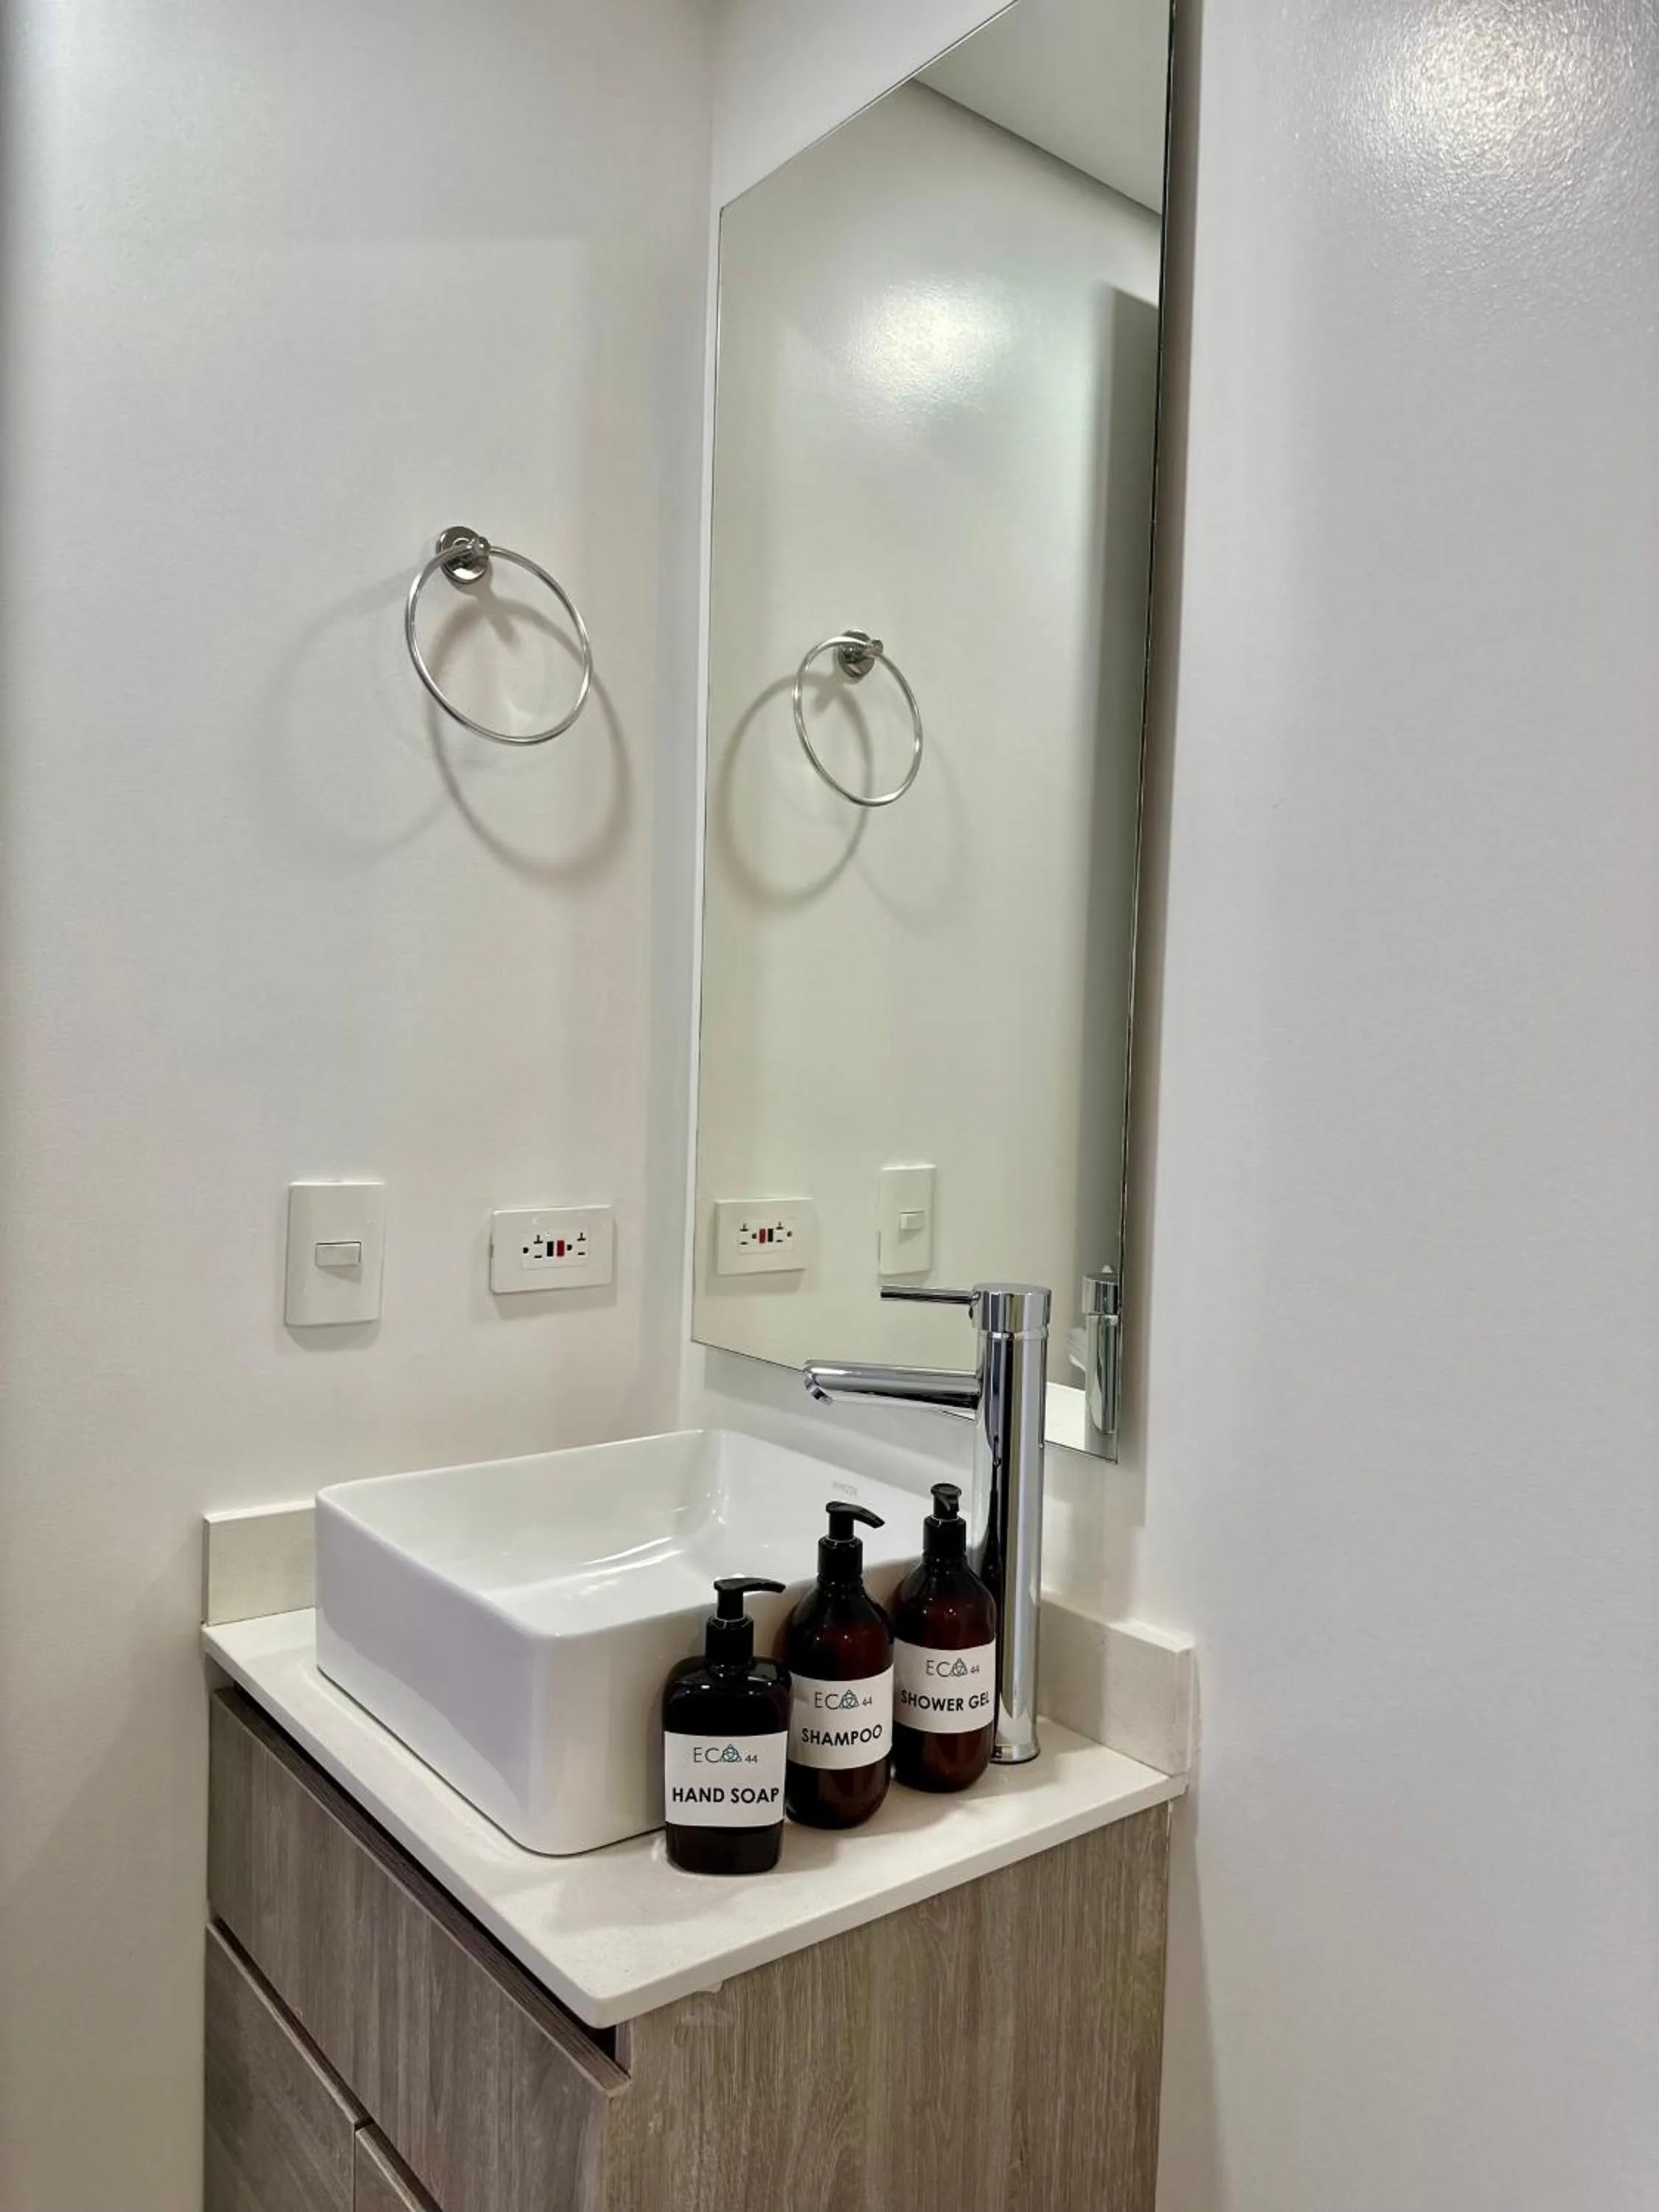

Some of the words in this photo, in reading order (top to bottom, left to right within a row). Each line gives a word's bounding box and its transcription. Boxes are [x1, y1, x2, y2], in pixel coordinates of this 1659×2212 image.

[900, 1688, 964, 1711] SHOWER
[968, 1691, 990, 1709] GEL
[801, 1724, 883, 1747] SHAMPOO
[745, 1754, 758, 1764] 44
[672, 1787, 725, 1803] HAND
[730, 1787, 779, 1804] SOAP
